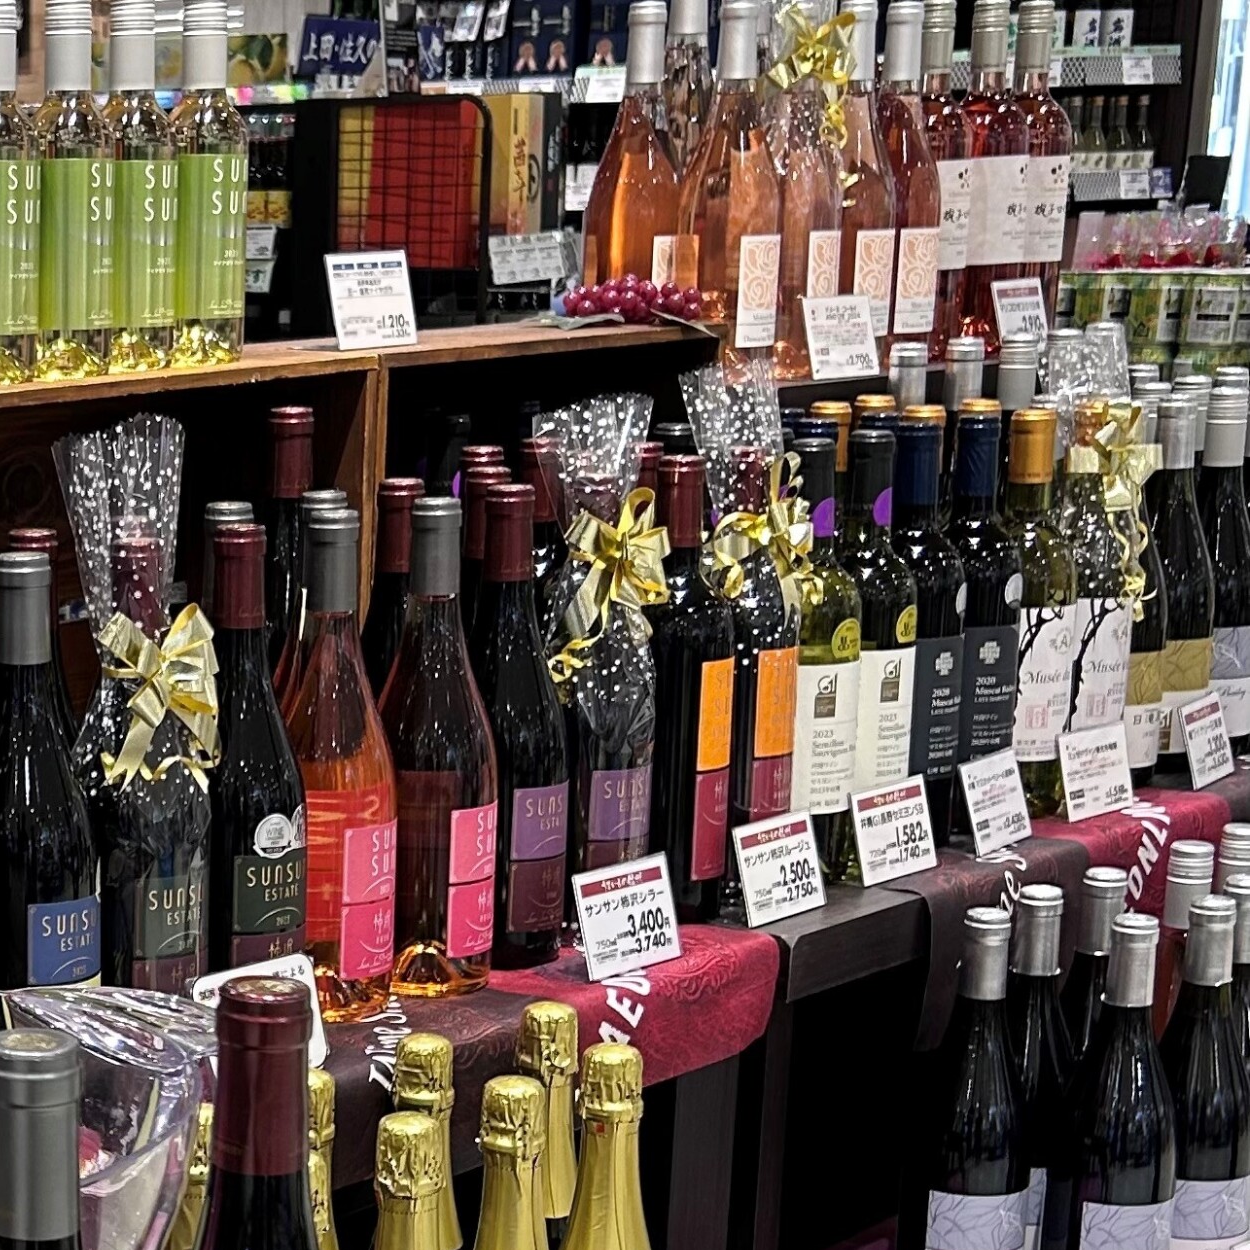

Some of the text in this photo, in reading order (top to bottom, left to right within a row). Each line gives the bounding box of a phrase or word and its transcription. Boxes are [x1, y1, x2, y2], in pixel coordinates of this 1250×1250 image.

[584, 888, 665, 918] サンサン柿沢シラー
